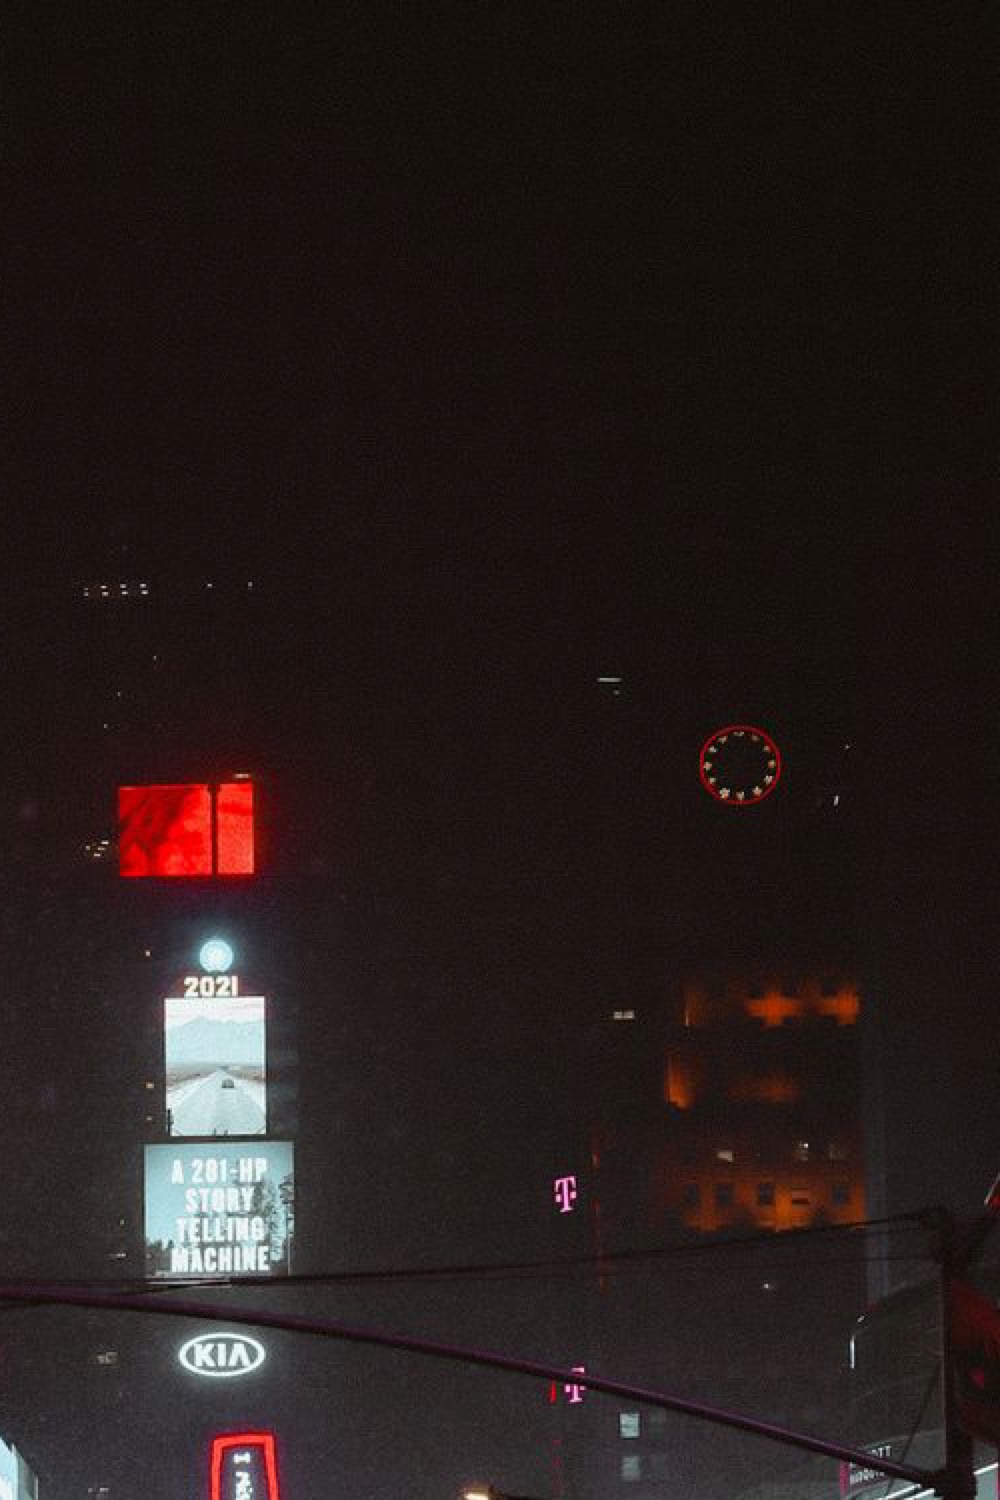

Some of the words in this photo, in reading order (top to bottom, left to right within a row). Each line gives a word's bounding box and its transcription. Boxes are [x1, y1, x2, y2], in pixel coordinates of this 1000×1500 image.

[183, 975, 239, 998] 2021
[171, 1159, 185, 1185] A
[185, 1187, 255, 1213] STORY
[175, 1217, 264, 1243] TELLING
[171, 1245, 270, 1273] MACHINE
[194, 1344, 252, 1369] KIA
